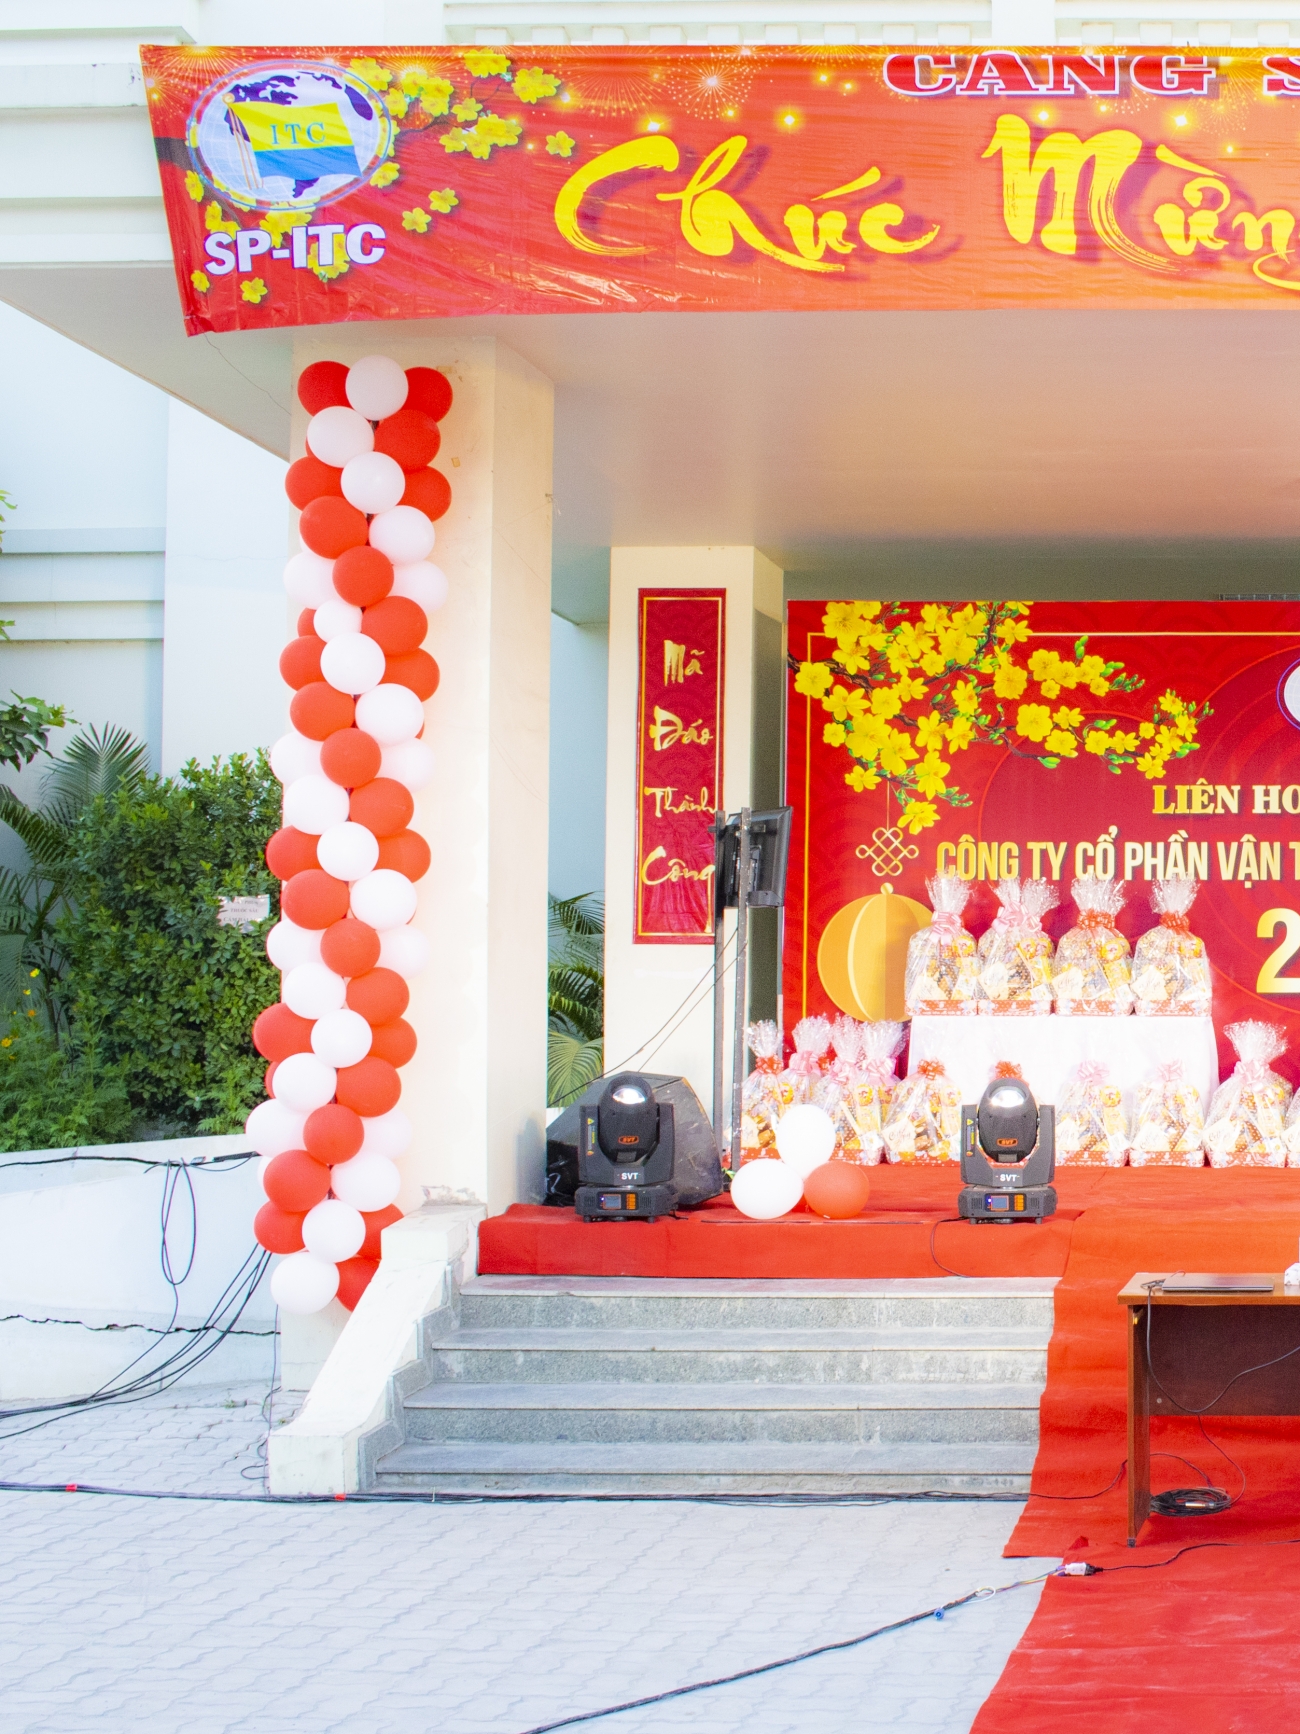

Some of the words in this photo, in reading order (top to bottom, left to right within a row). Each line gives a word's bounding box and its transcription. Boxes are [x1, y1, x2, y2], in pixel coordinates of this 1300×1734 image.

[270, 122, 327, 146] ITC
[554, 134, 941, 274] Chúc
[203, 222, 387, 276] SP-ITC
[649, 705, 714, 752] Đáo
[643, 786, 717, 819] Thành
[1151, 777, 1240, 816] LIÊN
[936, 833, 1020, 882] CÔNG
[1027, 840, 1068, 881] TY
[1074, 825, 1119, 882] CỔ
[1124, 829, 1209, 882] PHẦN
[1216, 833, 1281, 889] VẬN
[620, 1171, 639, 1181] SVT
[999, 1173, 1017, 1182] SVT
